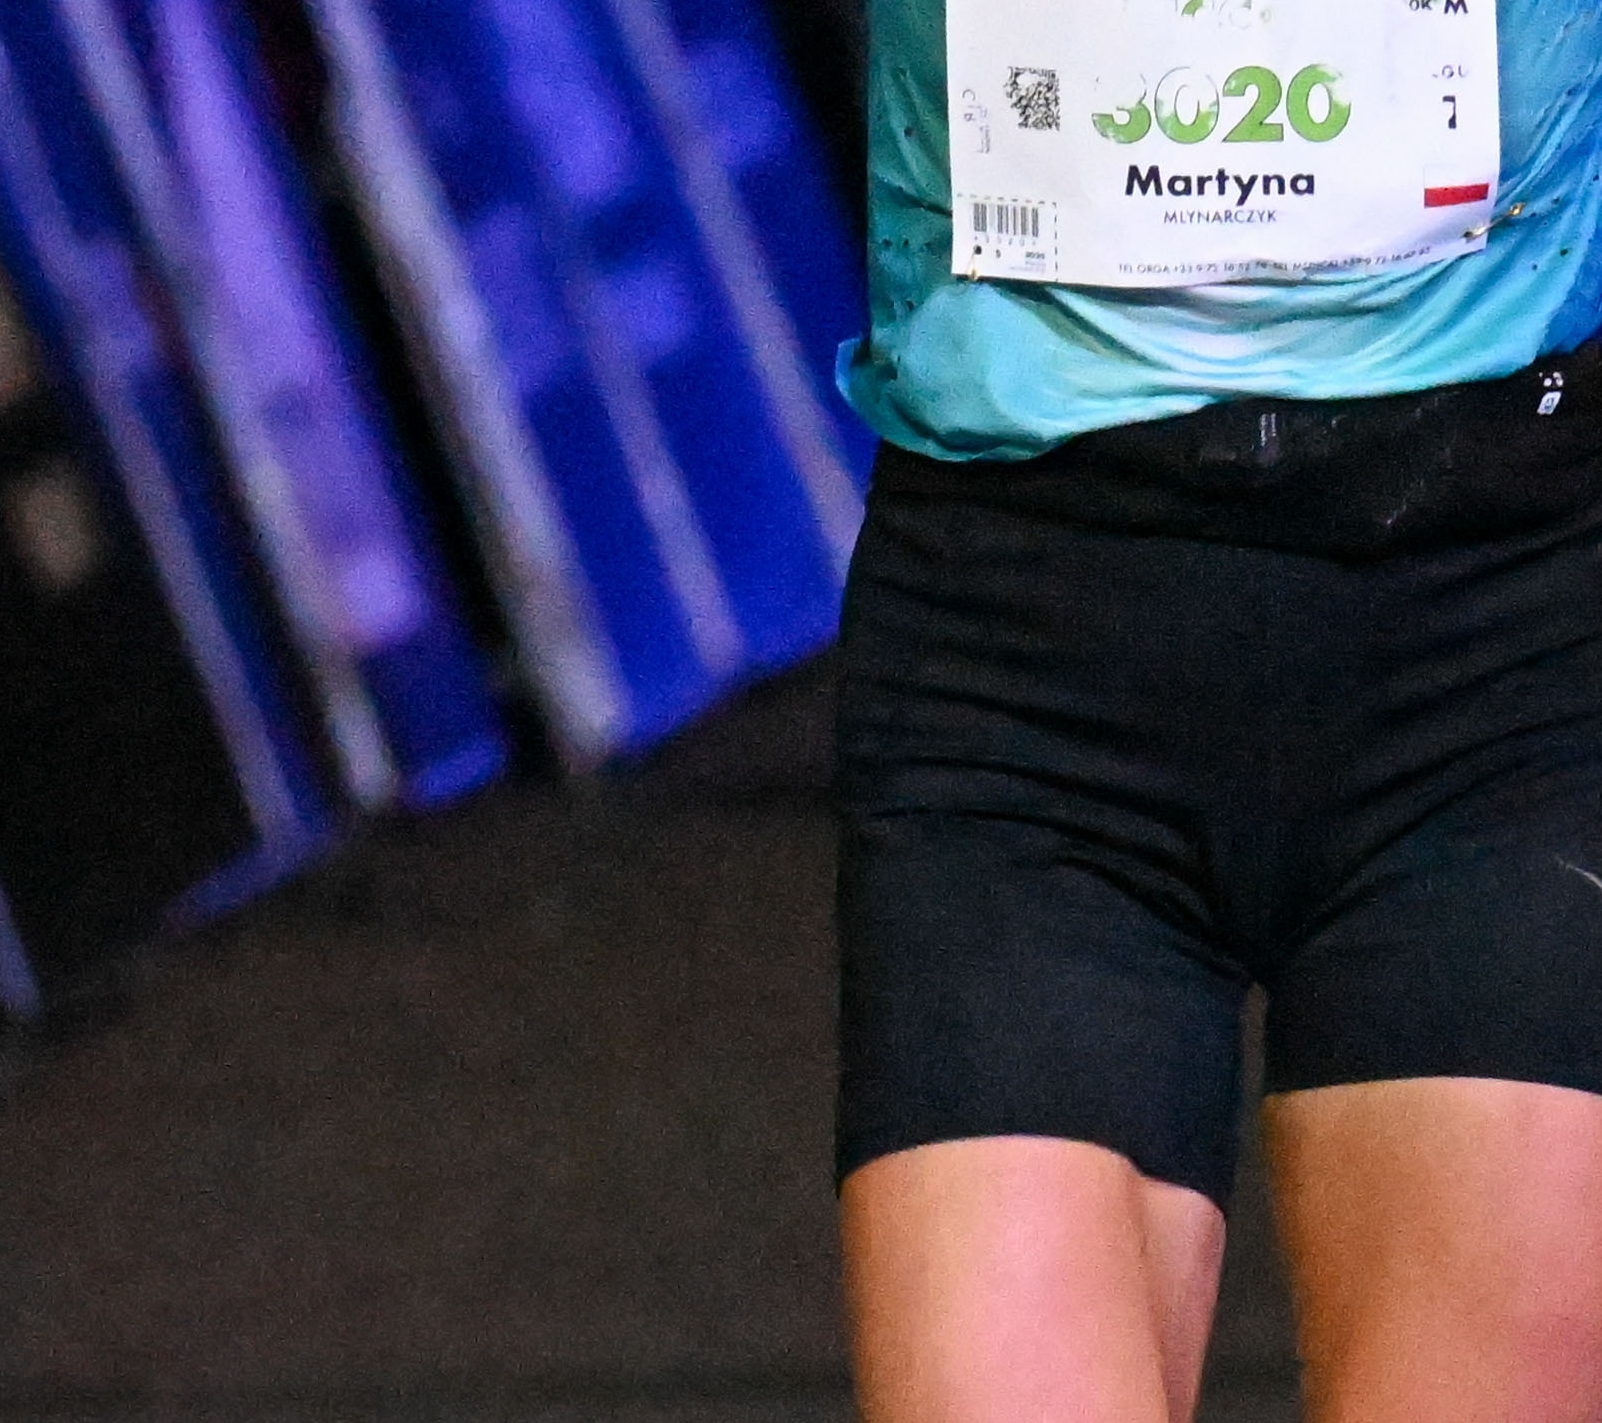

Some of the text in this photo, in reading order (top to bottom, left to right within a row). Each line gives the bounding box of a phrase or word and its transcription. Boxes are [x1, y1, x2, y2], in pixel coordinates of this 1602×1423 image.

[1091, 63, 1352, 145] 3020
[1125, 164, 1315, 207] Martyna
[1162, 208, 1278, 225] MLYNARCZYK
